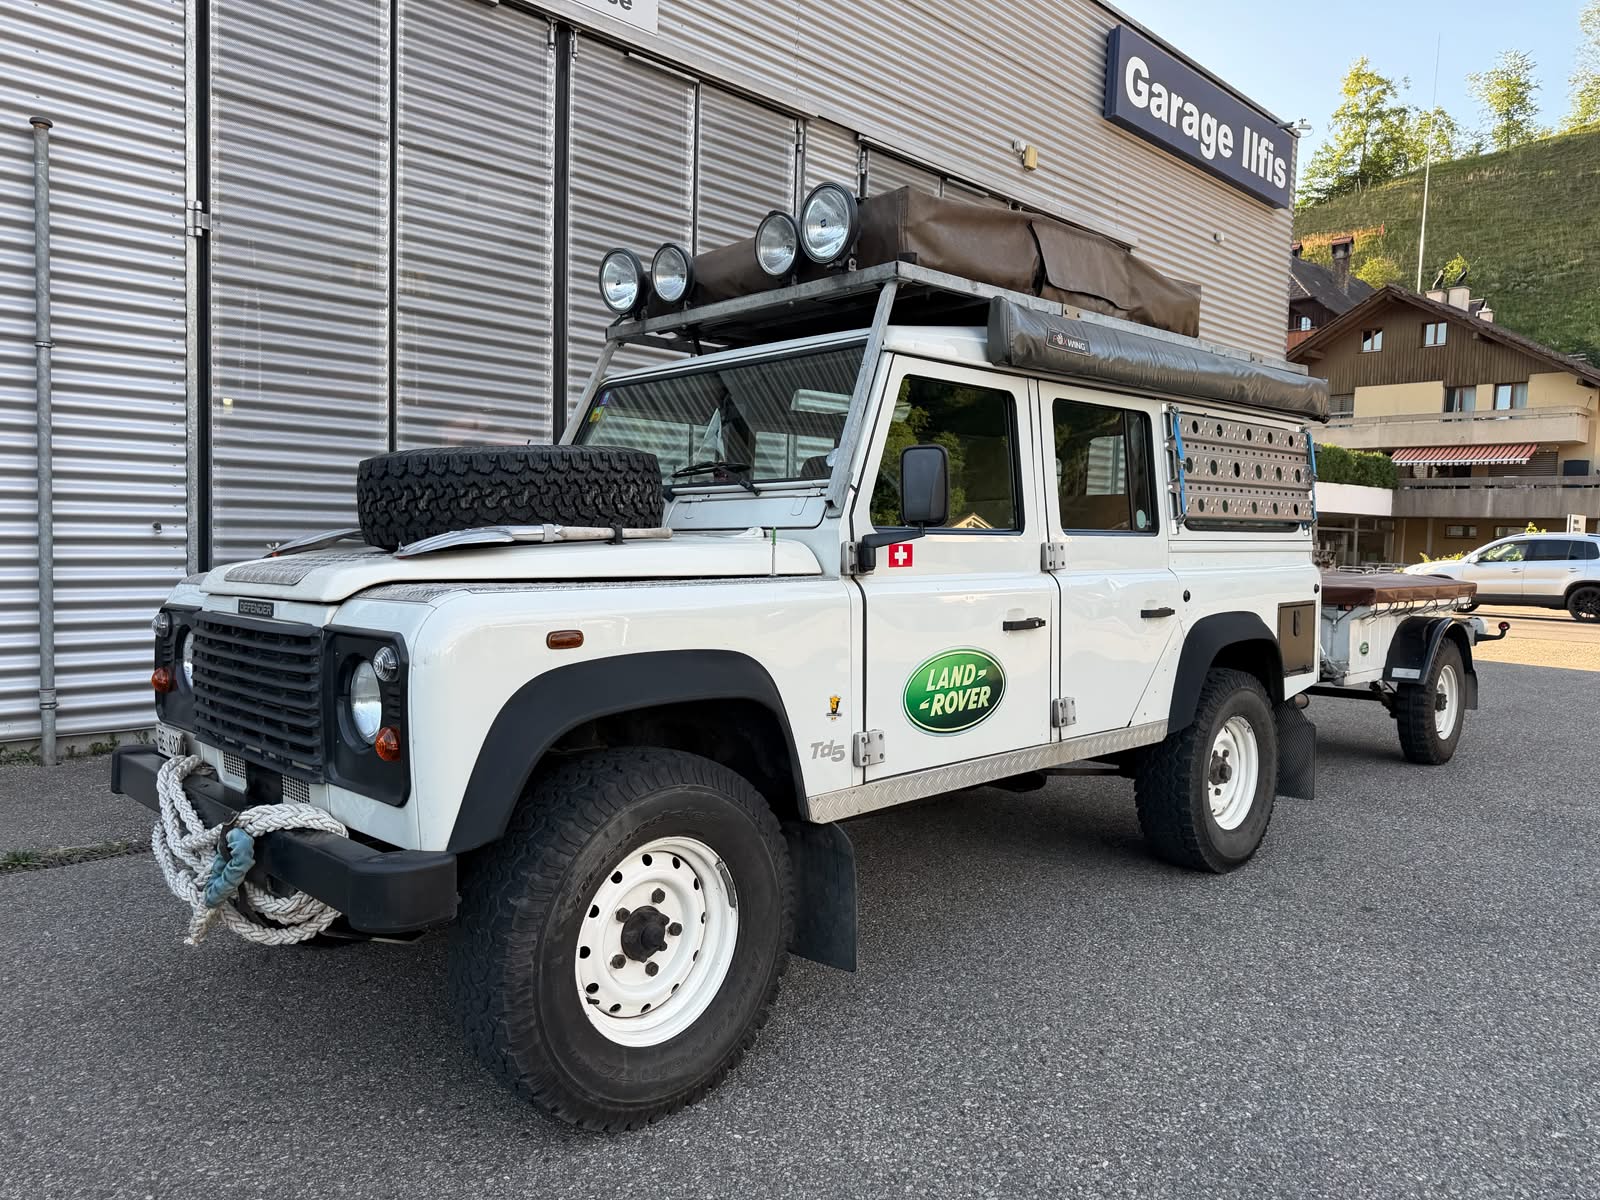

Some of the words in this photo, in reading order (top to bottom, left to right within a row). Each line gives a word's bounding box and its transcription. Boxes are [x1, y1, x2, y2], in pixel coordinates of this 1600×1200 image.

[1125, 56, 1234, 160] Garage
[1242, 125, 1287, 189] Ilfis
[240, 601, 272, 615] DEFENDER
[926, 663, 976, 692] LAND
[930, 685, 991, 717] ROVER
[810, 739, 846, 763] Td5
